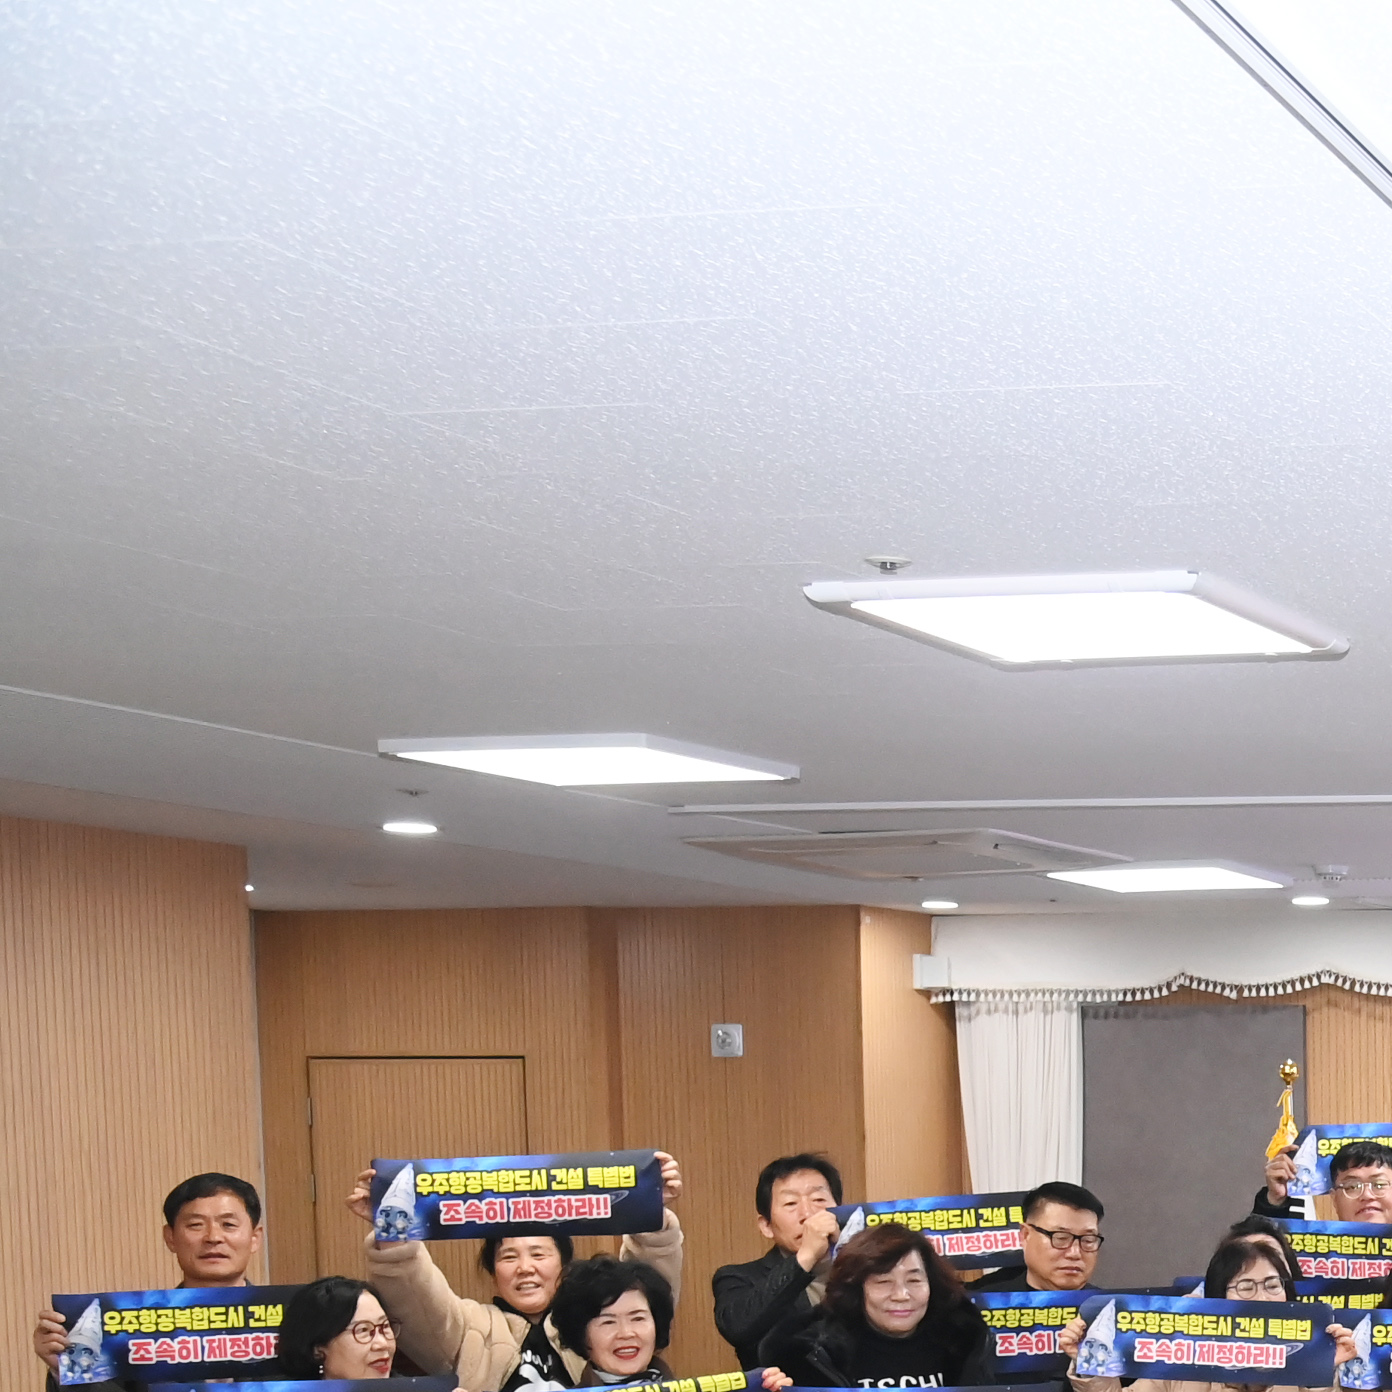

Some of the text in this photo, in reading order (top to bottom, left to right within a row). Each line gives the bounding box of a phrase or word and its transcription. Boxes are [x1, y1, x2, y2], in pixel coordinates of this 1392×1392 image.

[415, 1165, 636, 1196] 우주항공복합도시 건설 특별법
[440, 1194, 611, 1225] 조속히 제정하라!!
[102, 1303, 284, 1334] 우주항공복합도시 건설
[1117, 1311, 1312, 1341] 우주항공복합도시 건설 특별법
[128, 1335, 201, 1365] 조속히
[1134, 1340, 1289, 1368] 조속히 제정하라!!
